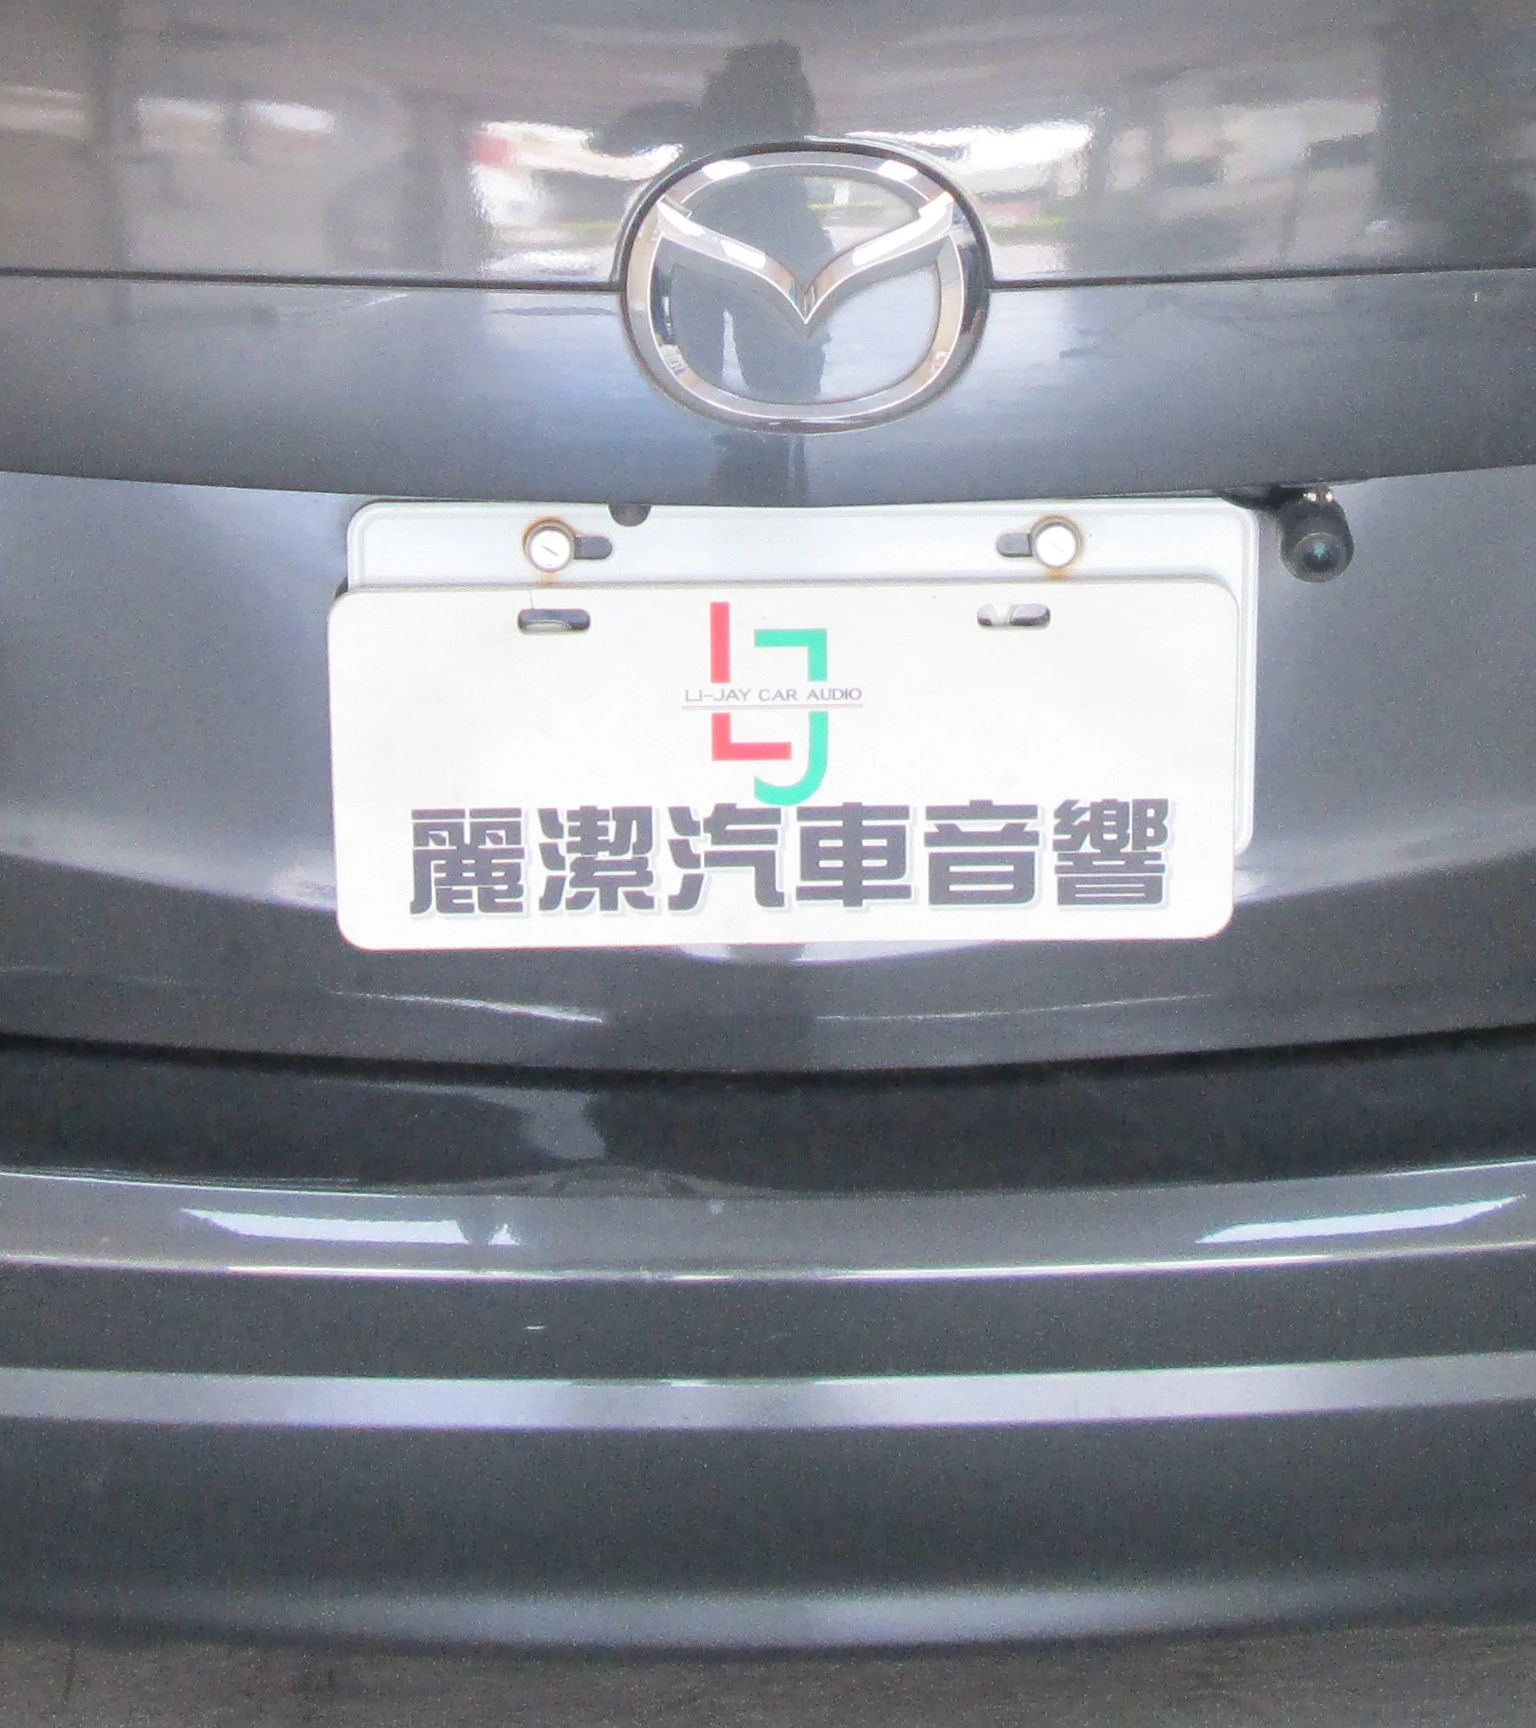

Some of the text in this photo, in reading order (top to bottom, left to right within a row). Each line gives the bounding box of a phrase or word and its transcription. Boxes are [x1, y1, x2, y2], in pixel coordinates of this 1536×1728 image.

[684, 686, 863, 702] LI-JAY CAR AUDIO
[407, 796, 1172, 917] 麗潔汽車音響
